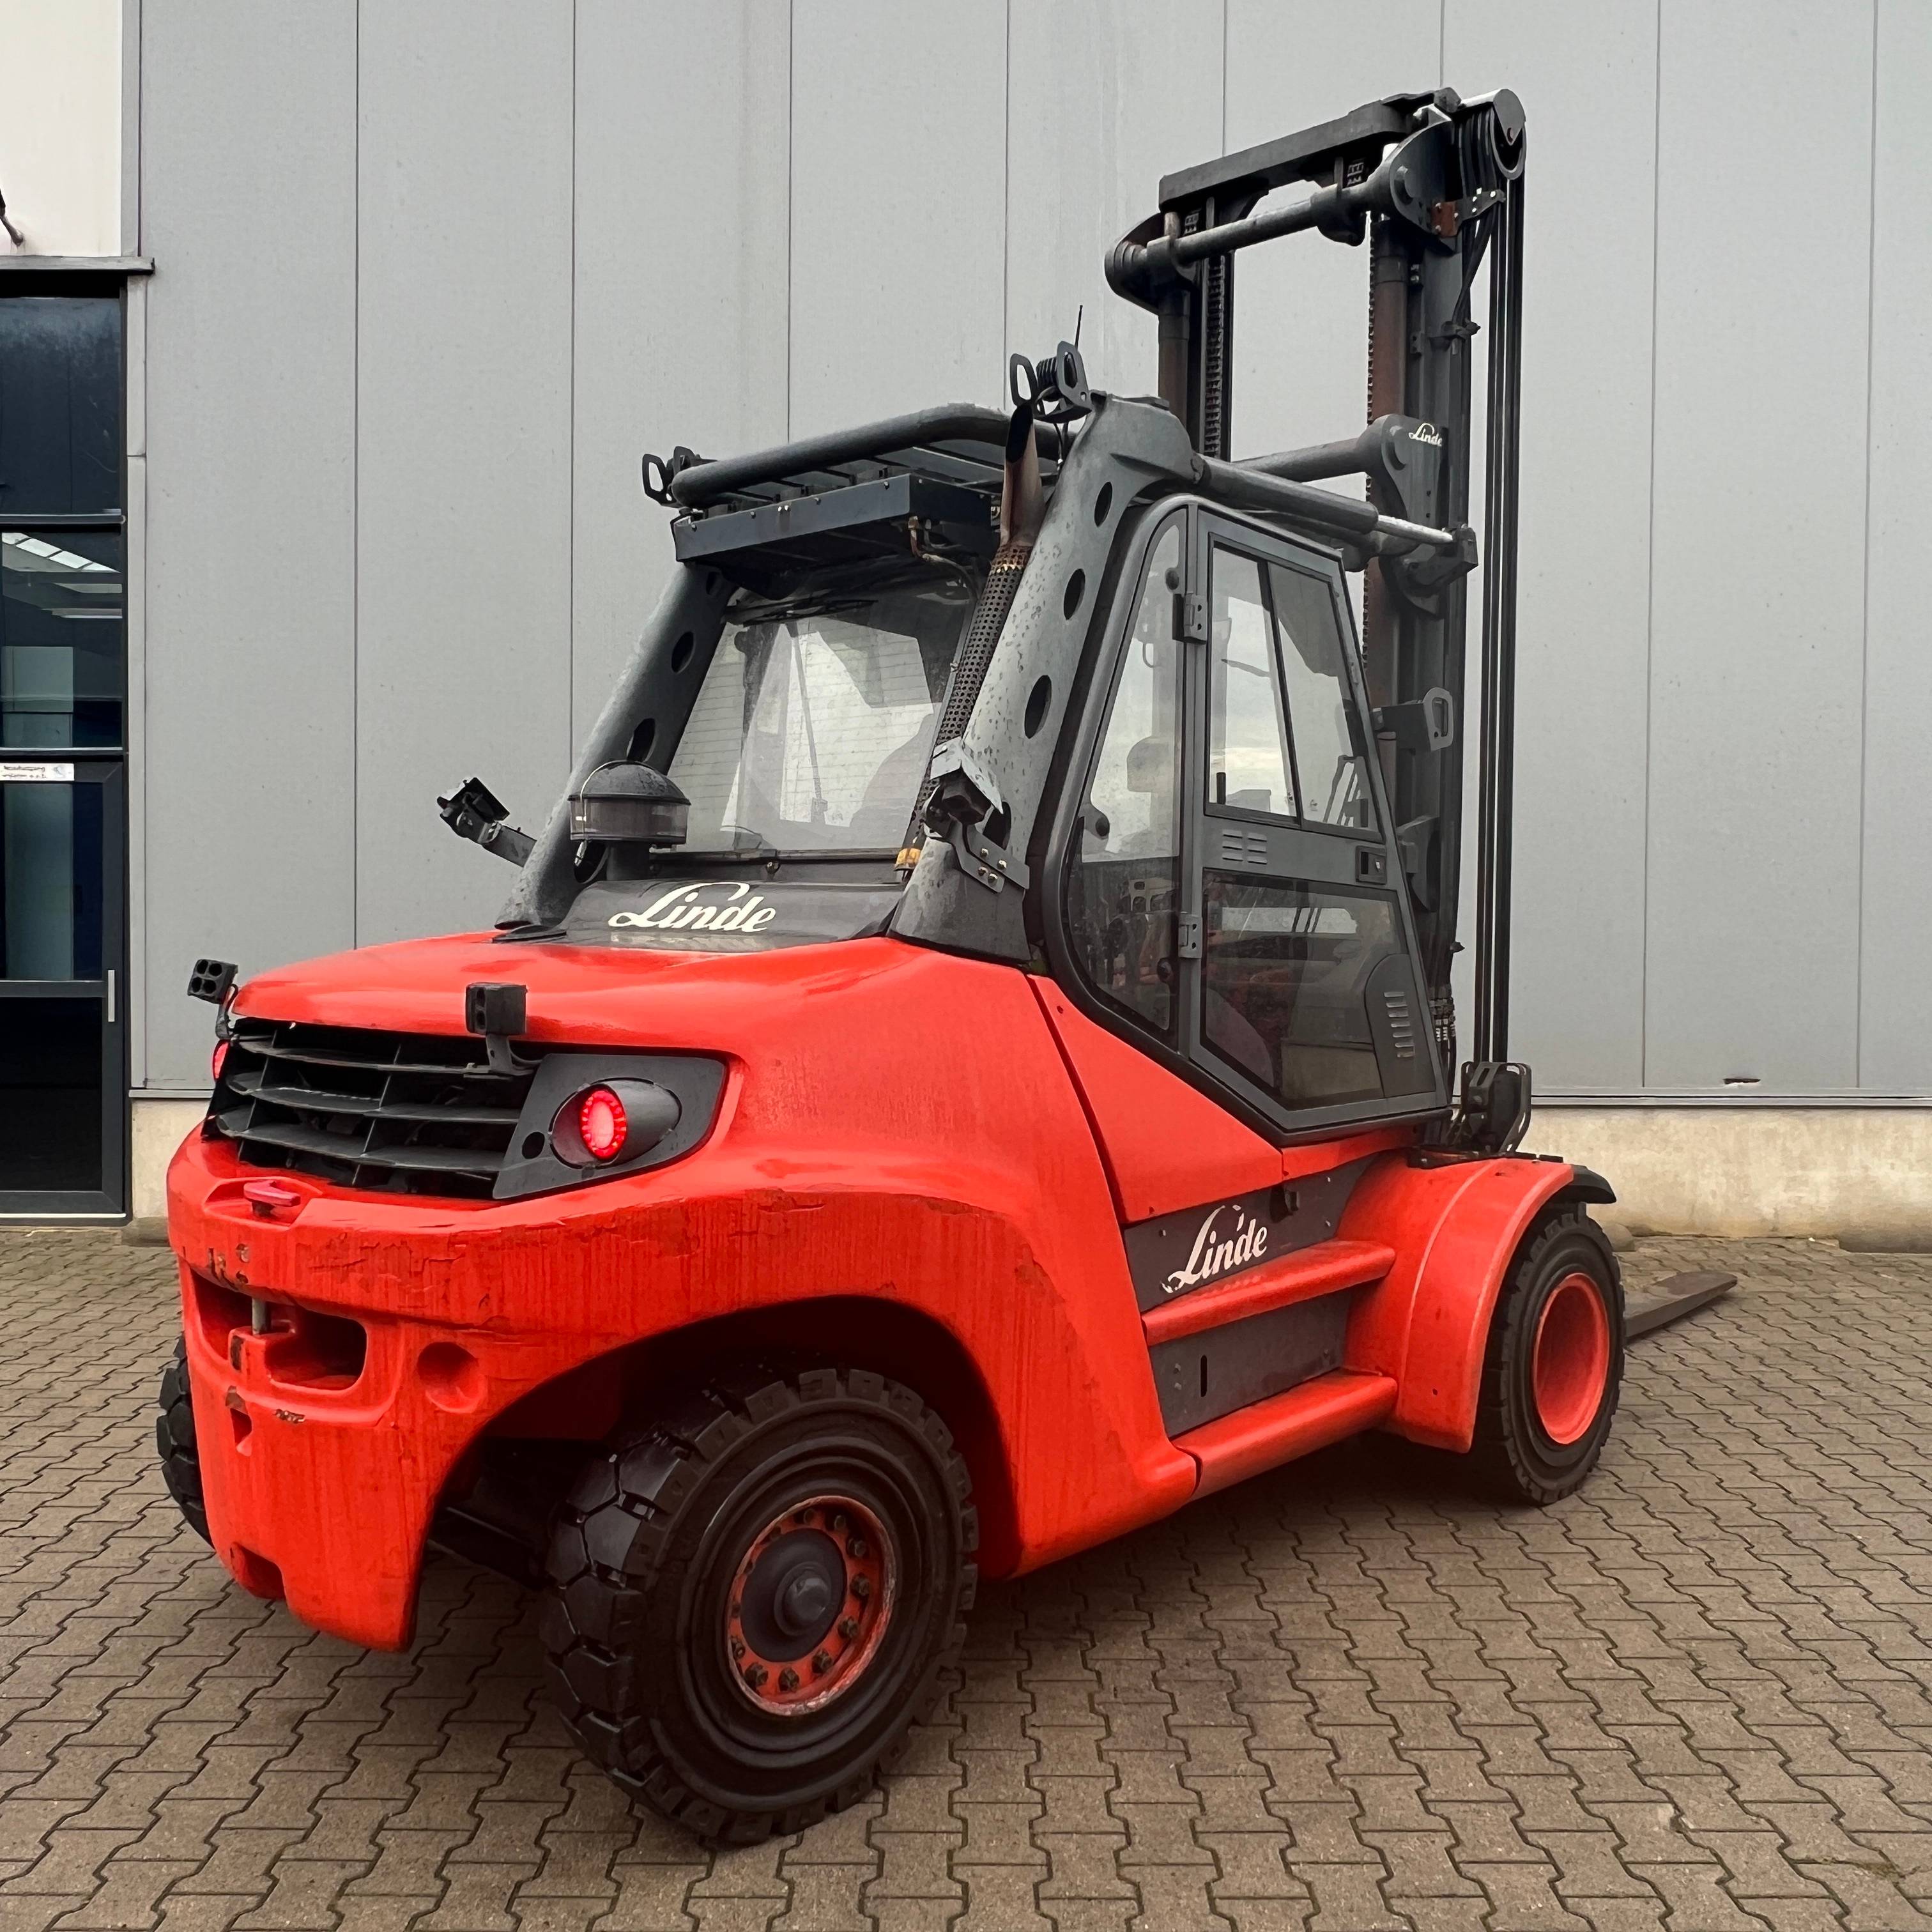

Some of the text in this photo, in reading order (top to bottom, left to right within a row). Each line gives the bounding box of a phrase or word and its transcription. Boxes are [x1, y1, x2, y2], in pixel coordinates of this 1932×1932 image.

[1409, 422, 1442, 447] Linde
[608, 882, 776, 932] Linde
[1160, 1204, 1267, 1293] Linde
